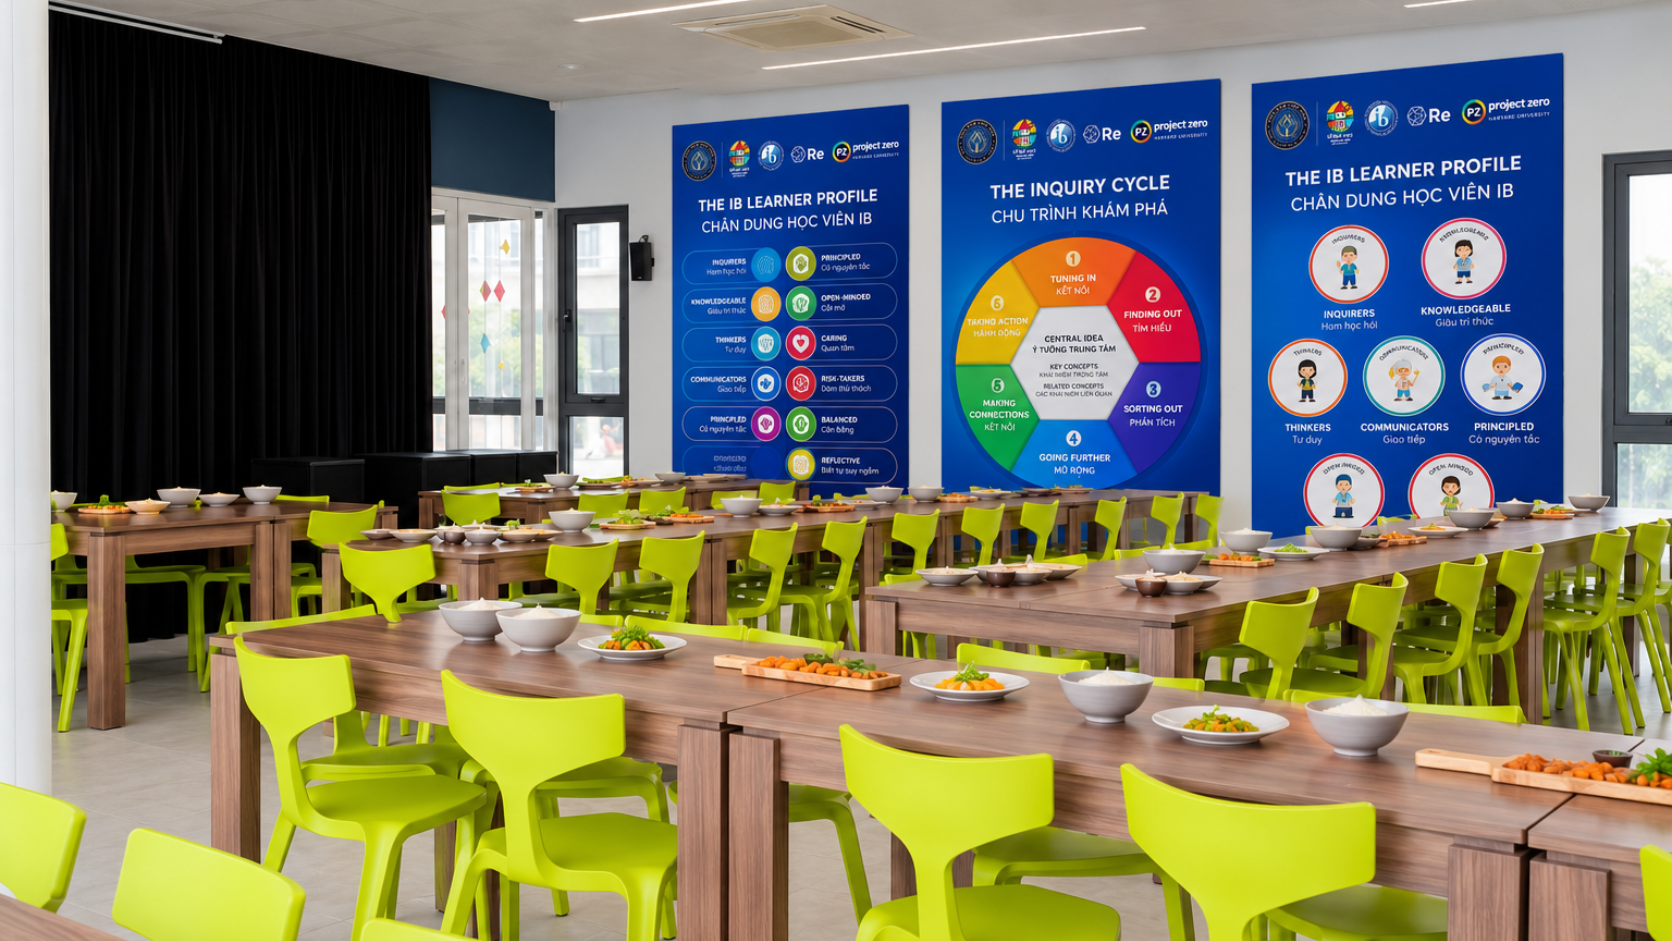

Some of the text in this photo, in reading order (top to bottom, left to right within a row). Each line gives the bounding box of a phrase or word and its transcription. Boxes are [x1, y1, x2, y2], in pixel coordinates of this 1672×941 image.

[1488, 98, 1550, 113] project zero
[1428, 108, 1451, 123] Re
[1467, 107, 1482, 117] PZ
[1154, 119, 1208, 133] project zero
[1102, 127, 1122, 141] Re
[1135, 127, 1148, 137] PZ
[836, 148, 848, 157] PZ
[852, 141, 899, 153] project zero
[807, 148, 825, 160] Re
[1285, 155, 1522, 186] THE IB LEARNER PROFILE
[990, 174, 1170, 199] THE INQUIRY CYCLE
[698, 188, 878, 212] THE IB LEARNER PROFILE
[1291, 182, 1514, 211] CHÂN DUNG HỌC VIÊN IB
[991, 198, 1168, 224] CHU TRÌNH KHÁM PHÁ
[702, 211, 872, 233] CHÂN DUNG HỌC VIÊN IB
[1050, 274, 1096, 283] TUNING IN
[1123, 309, 1182, 319] FINDING OUT
[1323, 308, 1375, 319] INQUIRERS
[1420, 303, 1511, 315] KNOWLEDGEABLE
[1044, 334, 1104, 343] CENTRAL IDEA
[1069, 345, 1097, 353] TRUNG
[982, 399, 1016, 407] MAKING
[1123, 404, 1183, 413] SORTING OUT
[1285, 423, 1331, 432] THINKERS
[1360, 423, 1449, 431] COMMUNICATORS
[1474, 422, 1534, 431] PRINCIPLED
[1305, 434, 1323, 446] duy
[1038, 453, 1111, 463] GOING FURTHER
